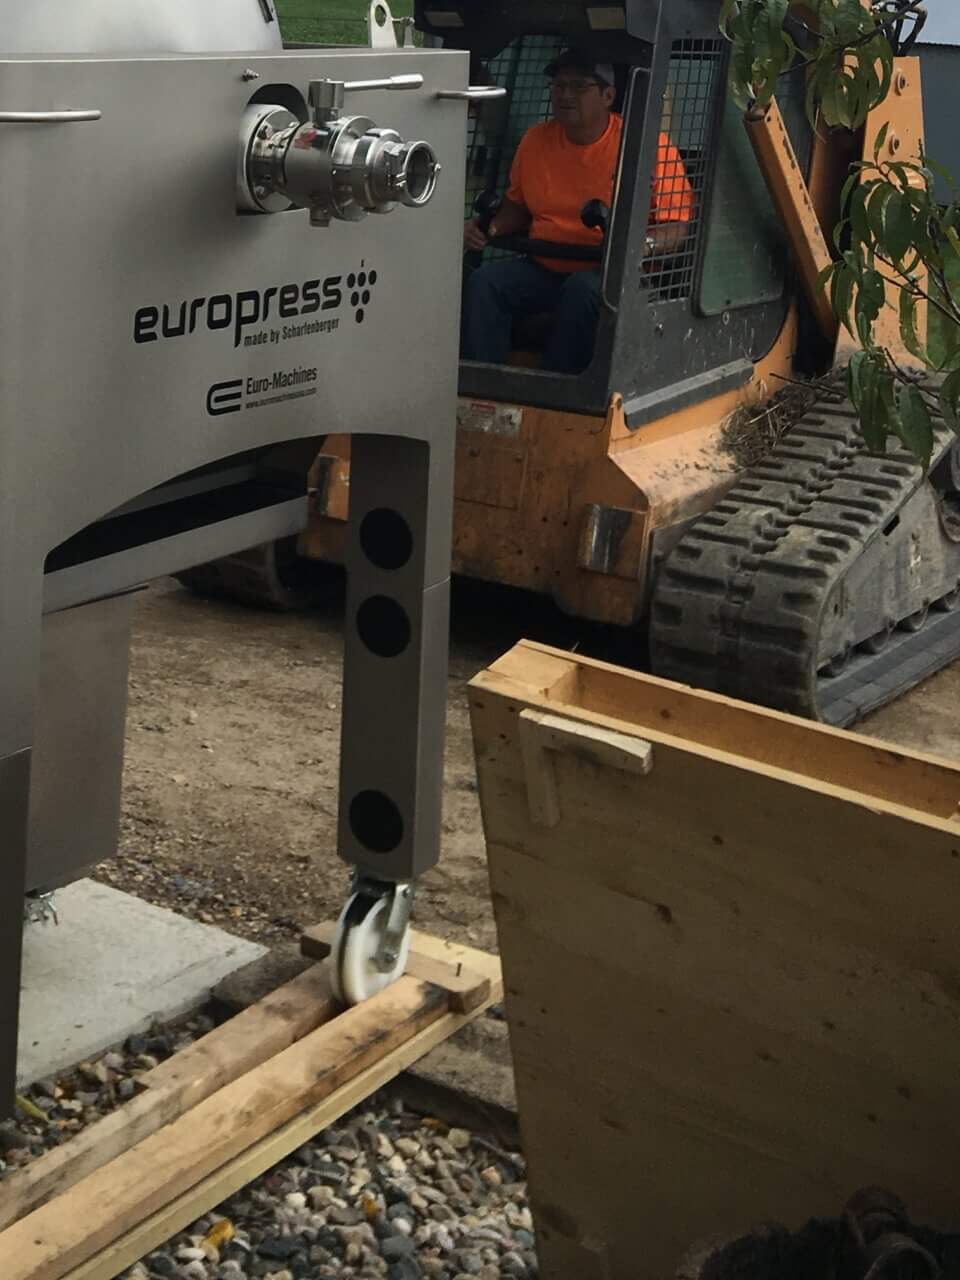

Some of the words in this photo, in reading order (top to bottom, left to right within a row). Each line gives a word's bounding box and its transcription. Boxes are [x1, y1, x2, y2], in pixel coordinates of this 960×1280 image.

[134, 275, 342, 348] europress
[244, 331, 268, 347] made
[269, 328, 280, 344] by
[246, 366, 317, 395] Euro-Machines
